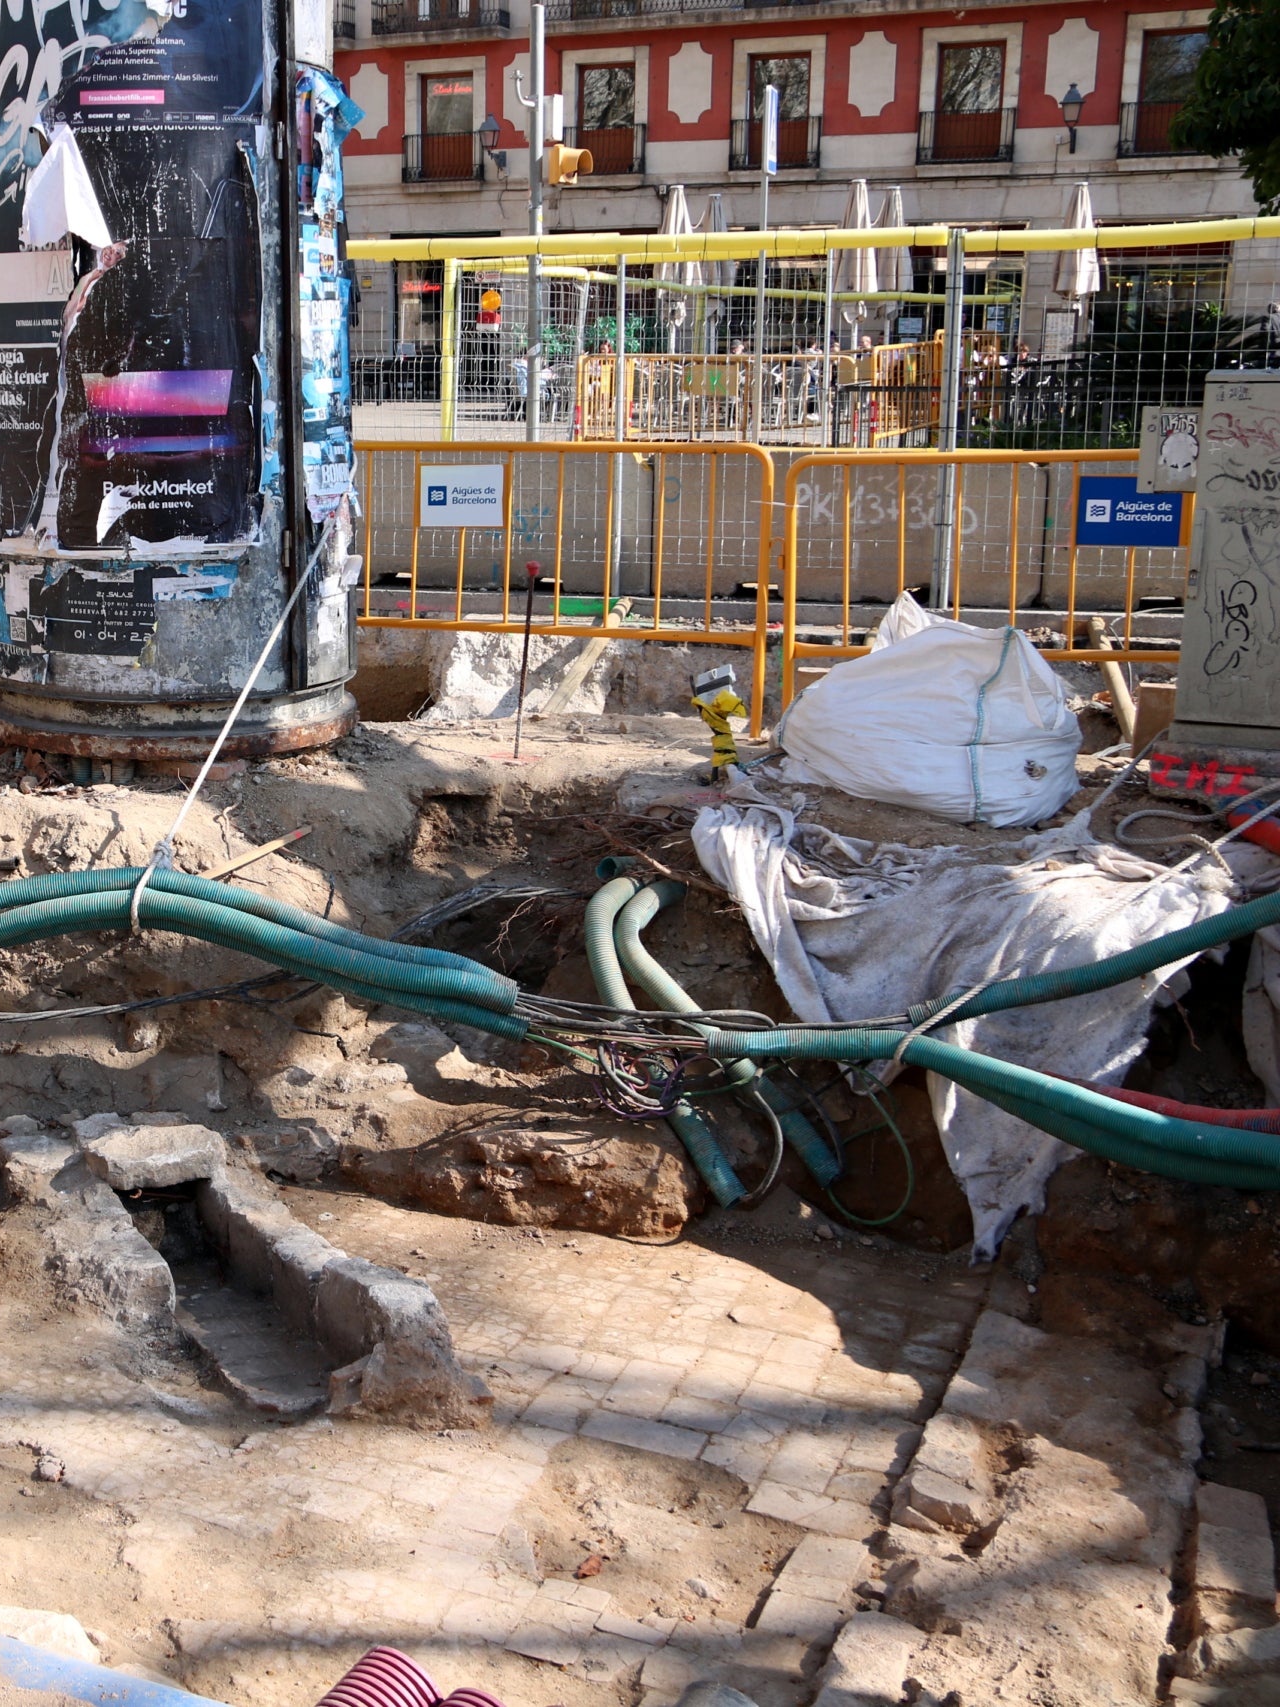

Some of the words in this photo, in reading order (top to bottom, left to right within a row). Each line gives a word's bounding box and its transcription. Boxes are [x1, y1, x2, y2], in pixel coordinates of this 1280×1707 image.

[156, 37, 186, 47] Batman,
[128, 47, 167, 57] Superman,
[92, 73, 118, 81] Elfman
[122, 73, 141, 81] Hans
[142, 73, 171, 81] Zimmer
[174, 73, 191, 81] Alan
[192, 73, 219, 81] Silvestri
[14, 370, 50, 386] tener
[153, 479, 215, 496] Market
[452, 486, 482, 497] Aigües
[484, 486, 496, 495] de
[148, 500, 160, 510] de
[161, 500, 194, 510] nuevo.
[452, 496, 497, 506] Barcelona
[1115, 500, 1156, 513] Aigües
[1157, 501, 1173, 511] de
[1115, 512, 1173, 522] Barcelona
